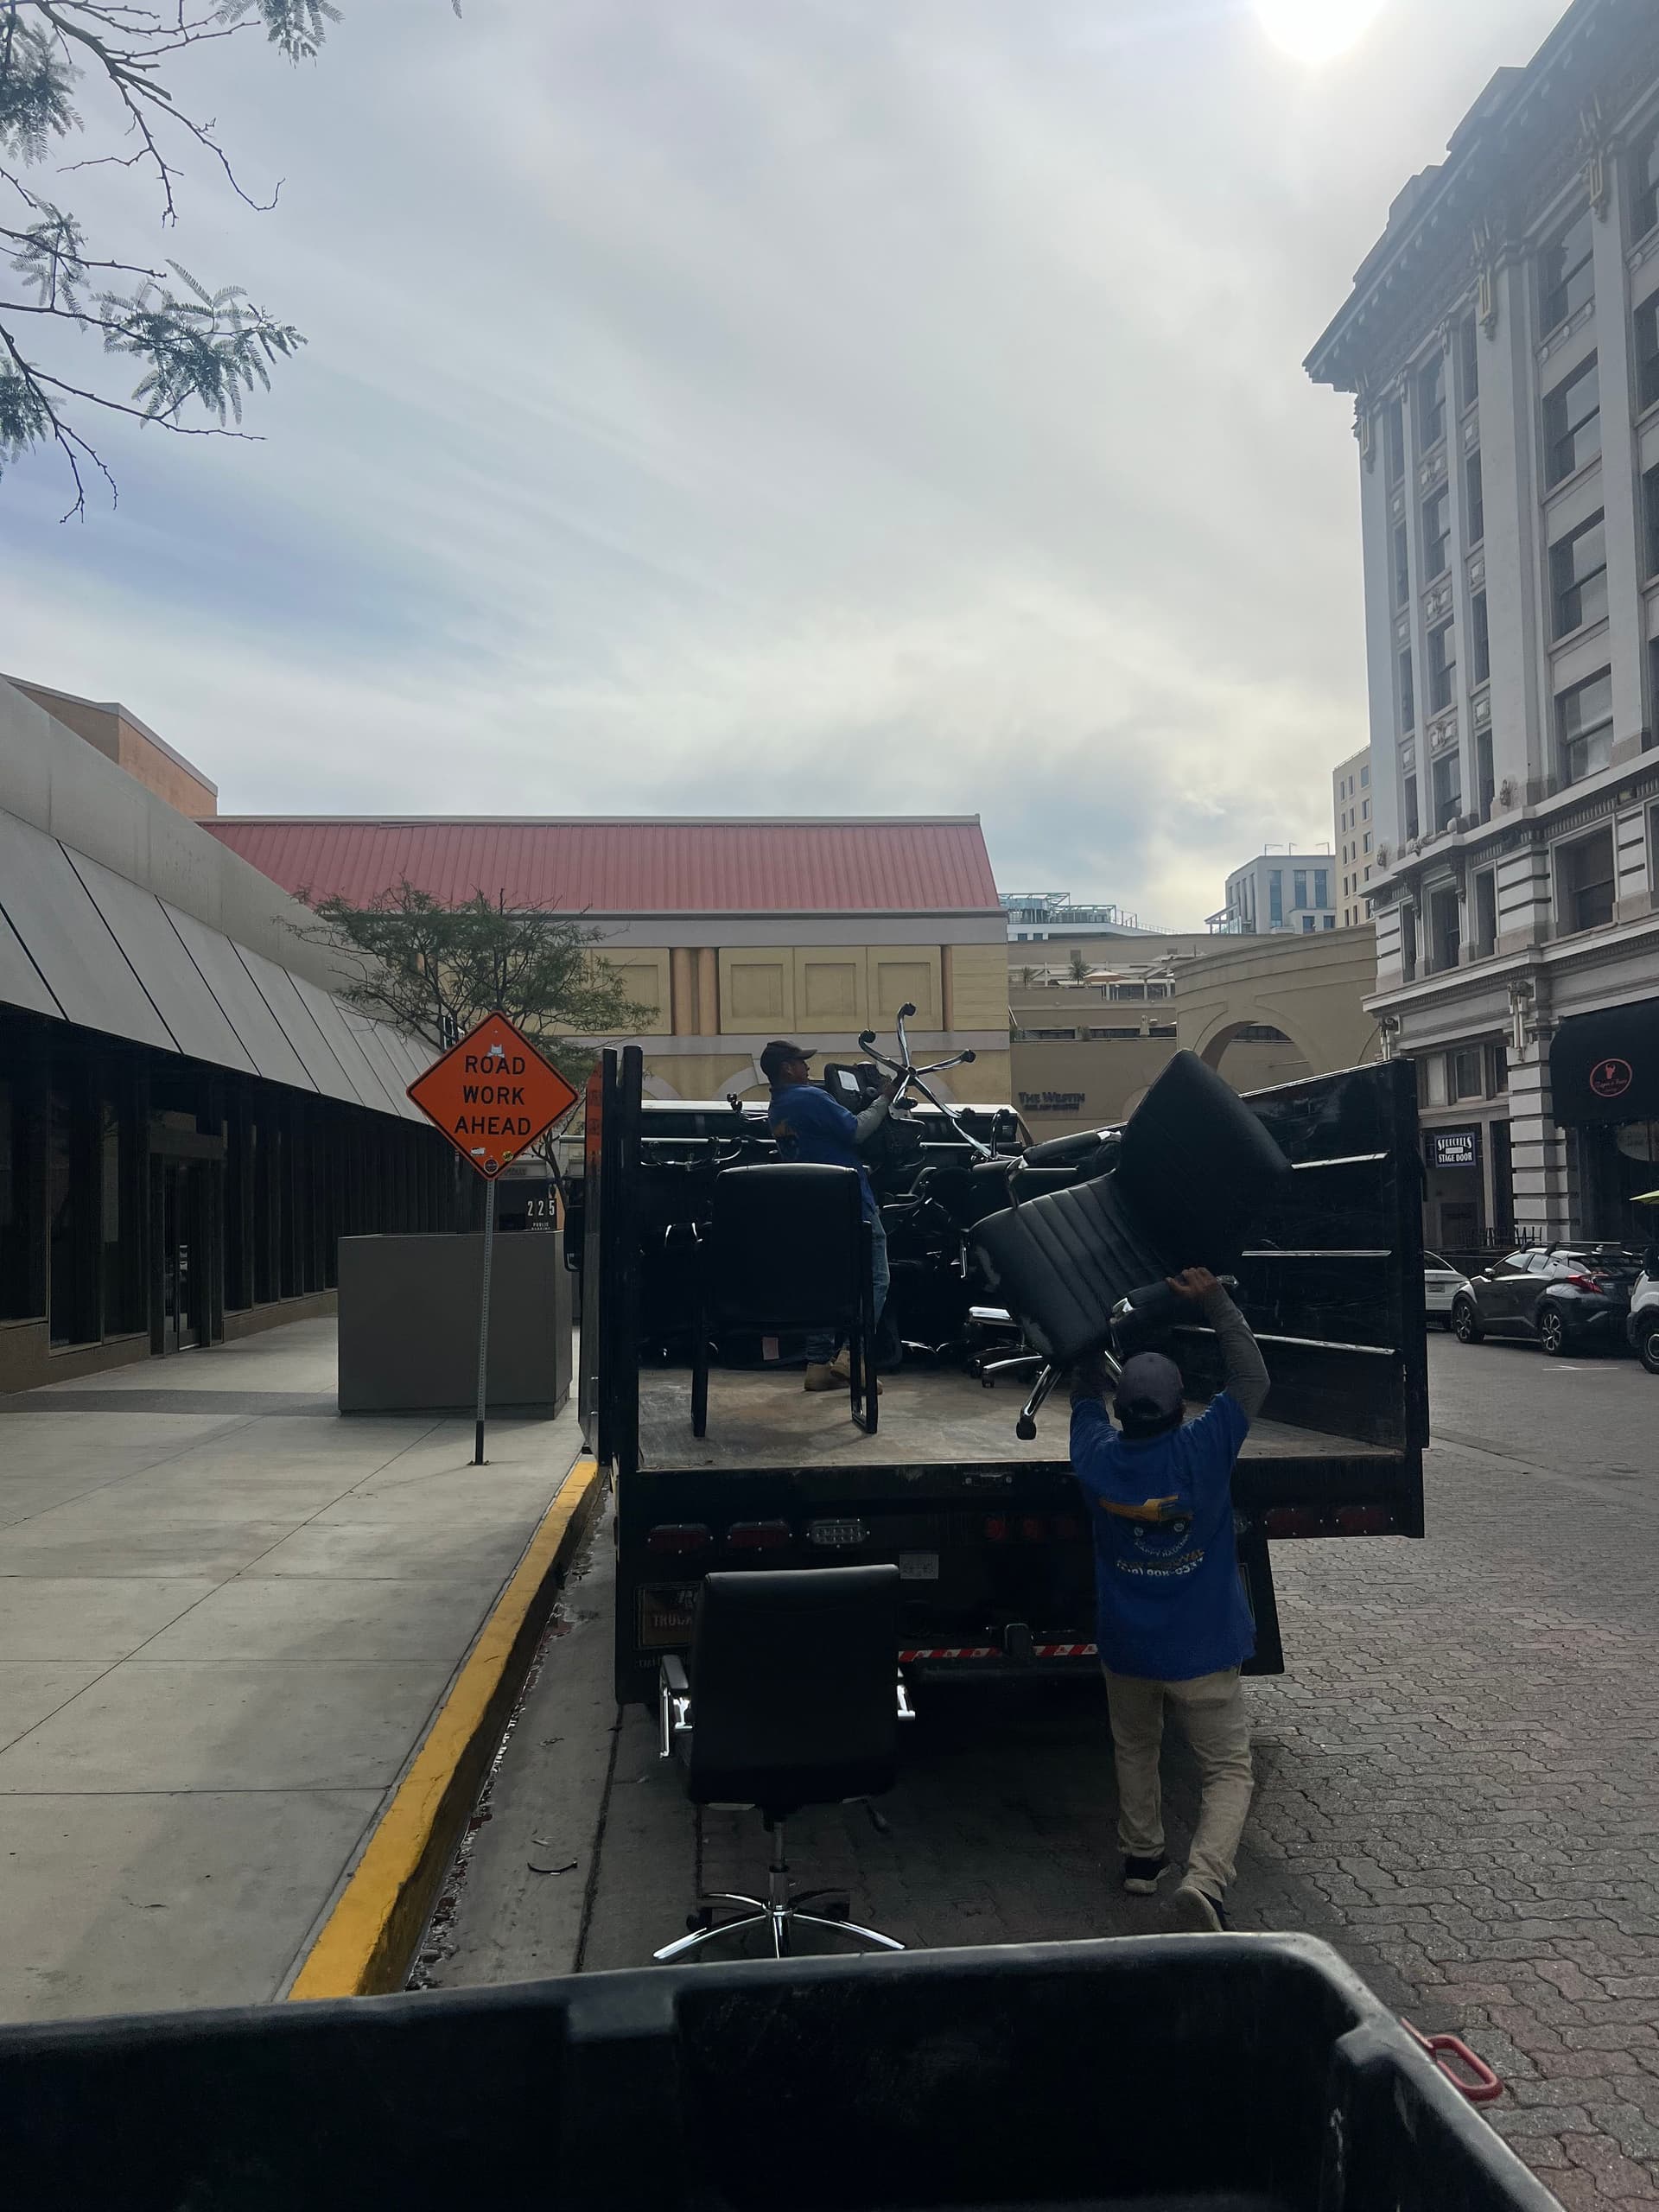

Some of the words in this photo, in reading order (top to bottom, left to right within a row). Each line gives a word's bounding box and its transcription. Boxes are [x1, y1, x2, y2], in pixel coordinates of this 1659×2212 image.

[465, 1055, 525, 1075] ROAD
[462, 1085, 524, 1105] WORK
[454, 1116, 531, 1135] AHEAD
[1438, 1154, 1455, 1163] STAGE
[1455, 1152, 1472, 1162] DOOR
[527, 1199, 555, 1217] 225
